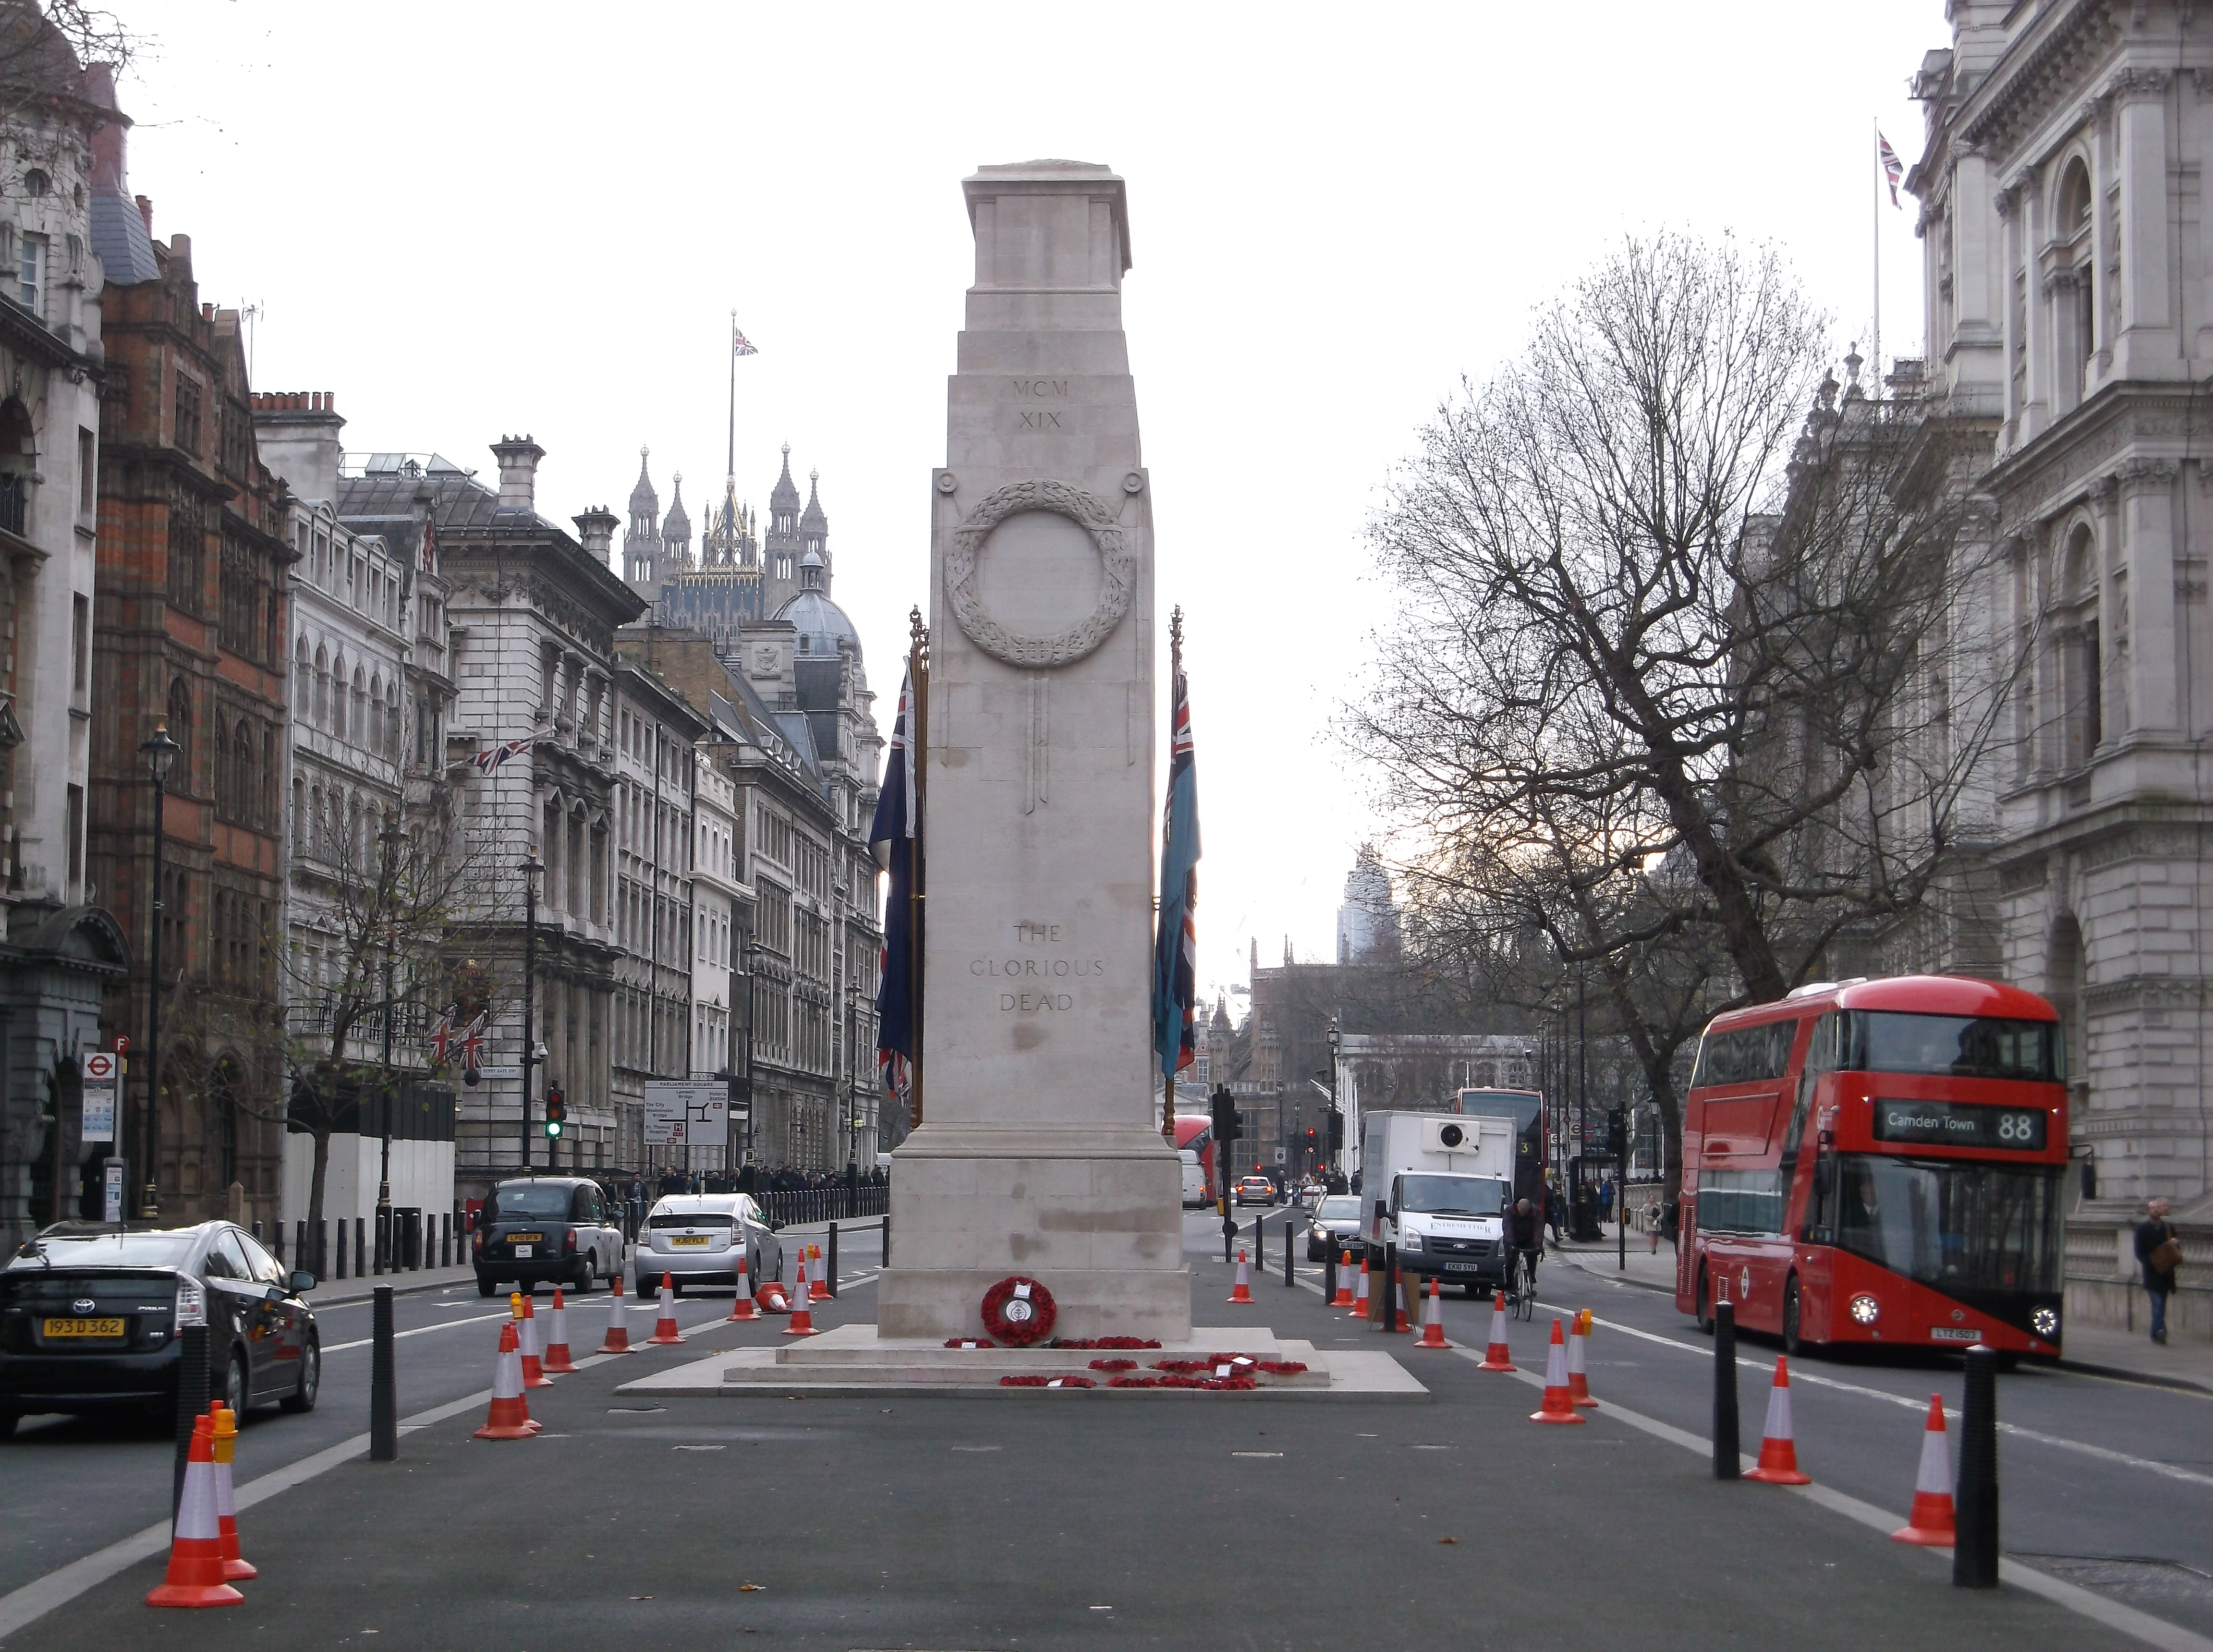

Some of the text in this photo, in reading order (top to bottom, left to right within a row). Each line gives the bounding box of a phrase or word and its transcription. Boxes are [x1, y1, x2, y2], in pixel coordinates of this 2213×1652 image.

[1014, 381, 1067, 397] MCM
[1020, 412, 1061, 428] XIX
[1013, 925, 1060, 942] THE
[970, 960, 1104, 976] GLORIOUS
[1000, 994, 1072, 1011] DEAD
[117, 1038, 126, 1051] F
[1888, 1112, 2031, 1140] Camden Town 88
[1521, 1142, 1529, 1153] 3
[49, 1320, 119, 1333] 193 D 362
[1936, 1329, 1975, 1339] LTZ 1503
